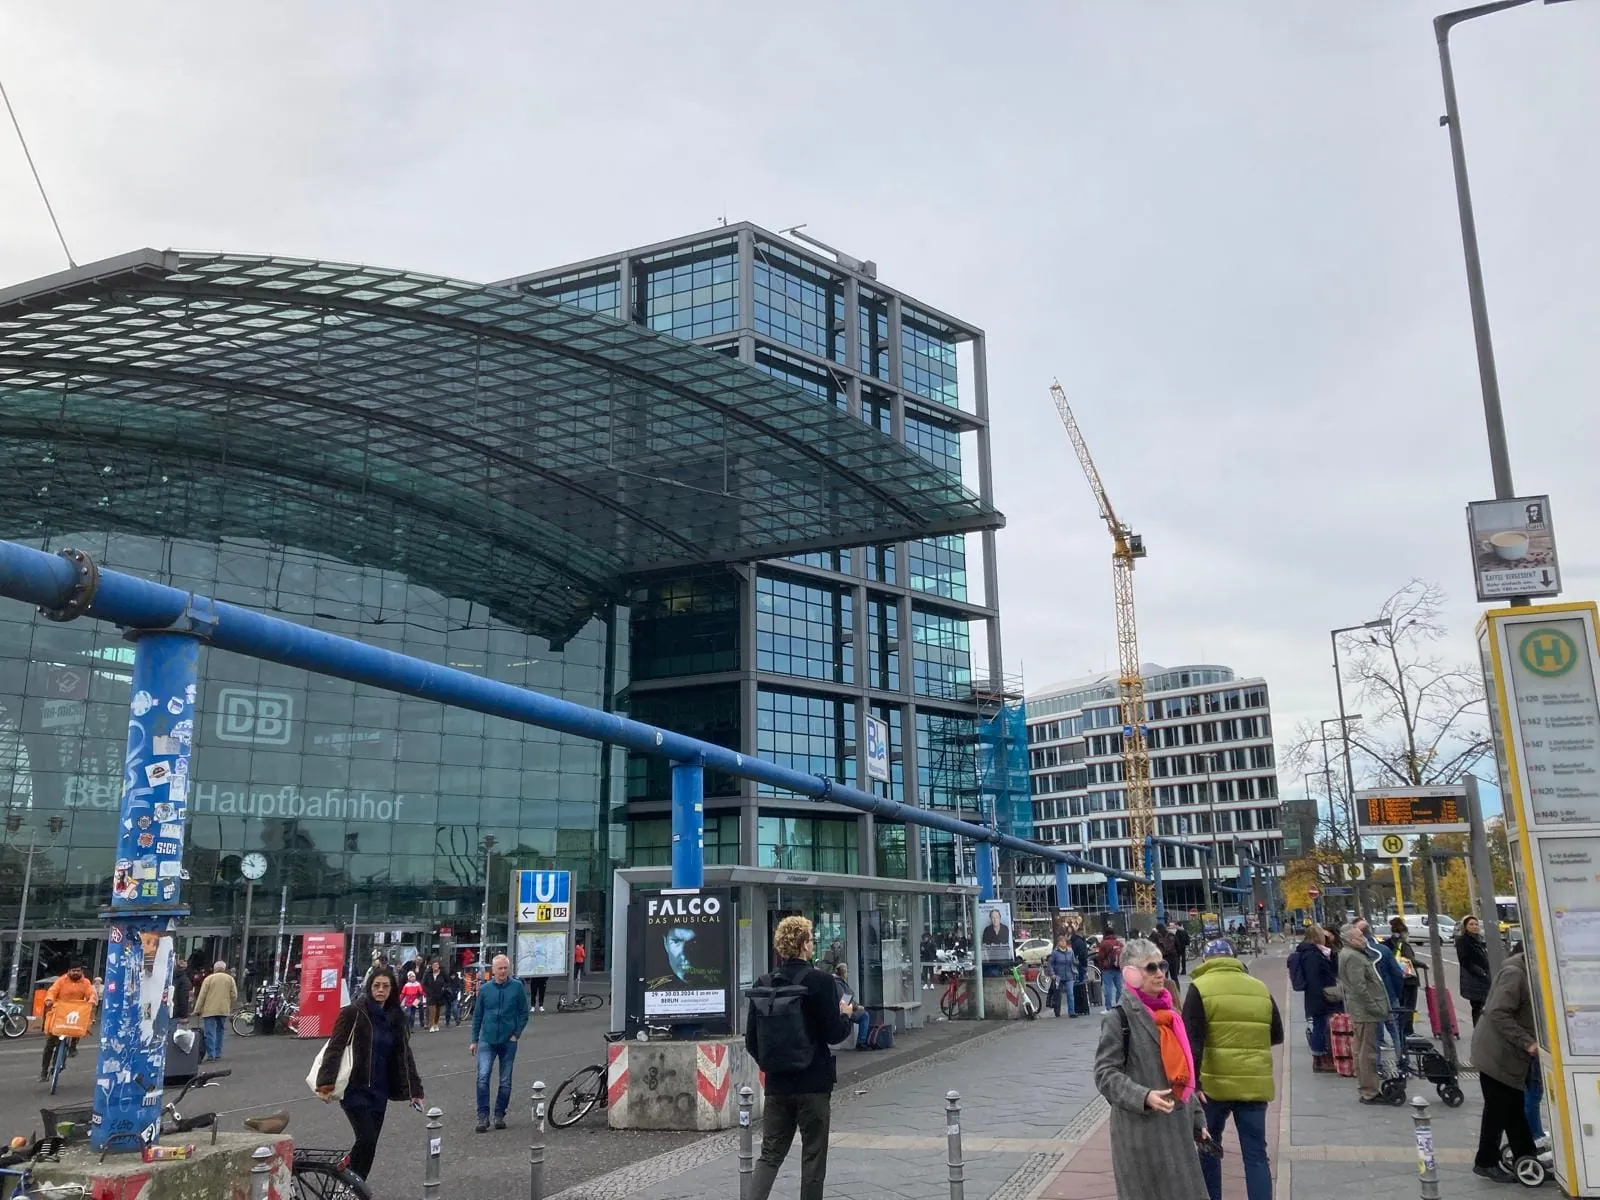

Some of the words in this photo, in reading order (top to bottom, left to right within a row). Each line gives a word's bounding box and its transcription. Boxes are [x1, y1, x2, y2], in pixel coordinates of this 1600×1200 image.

[1533, 639, 1563, 667] H
[226, 697, 283, 736] DB
[195, 783, 403, 822] Hauptbahnhof
[1388, 839, 1398, 849] H
[535, 873, 555, 902] U
[554, 908, 567, 917] U5
[648, 897, 720, 916] FALCO
[674, 915, 720, 923] MUSICAL
